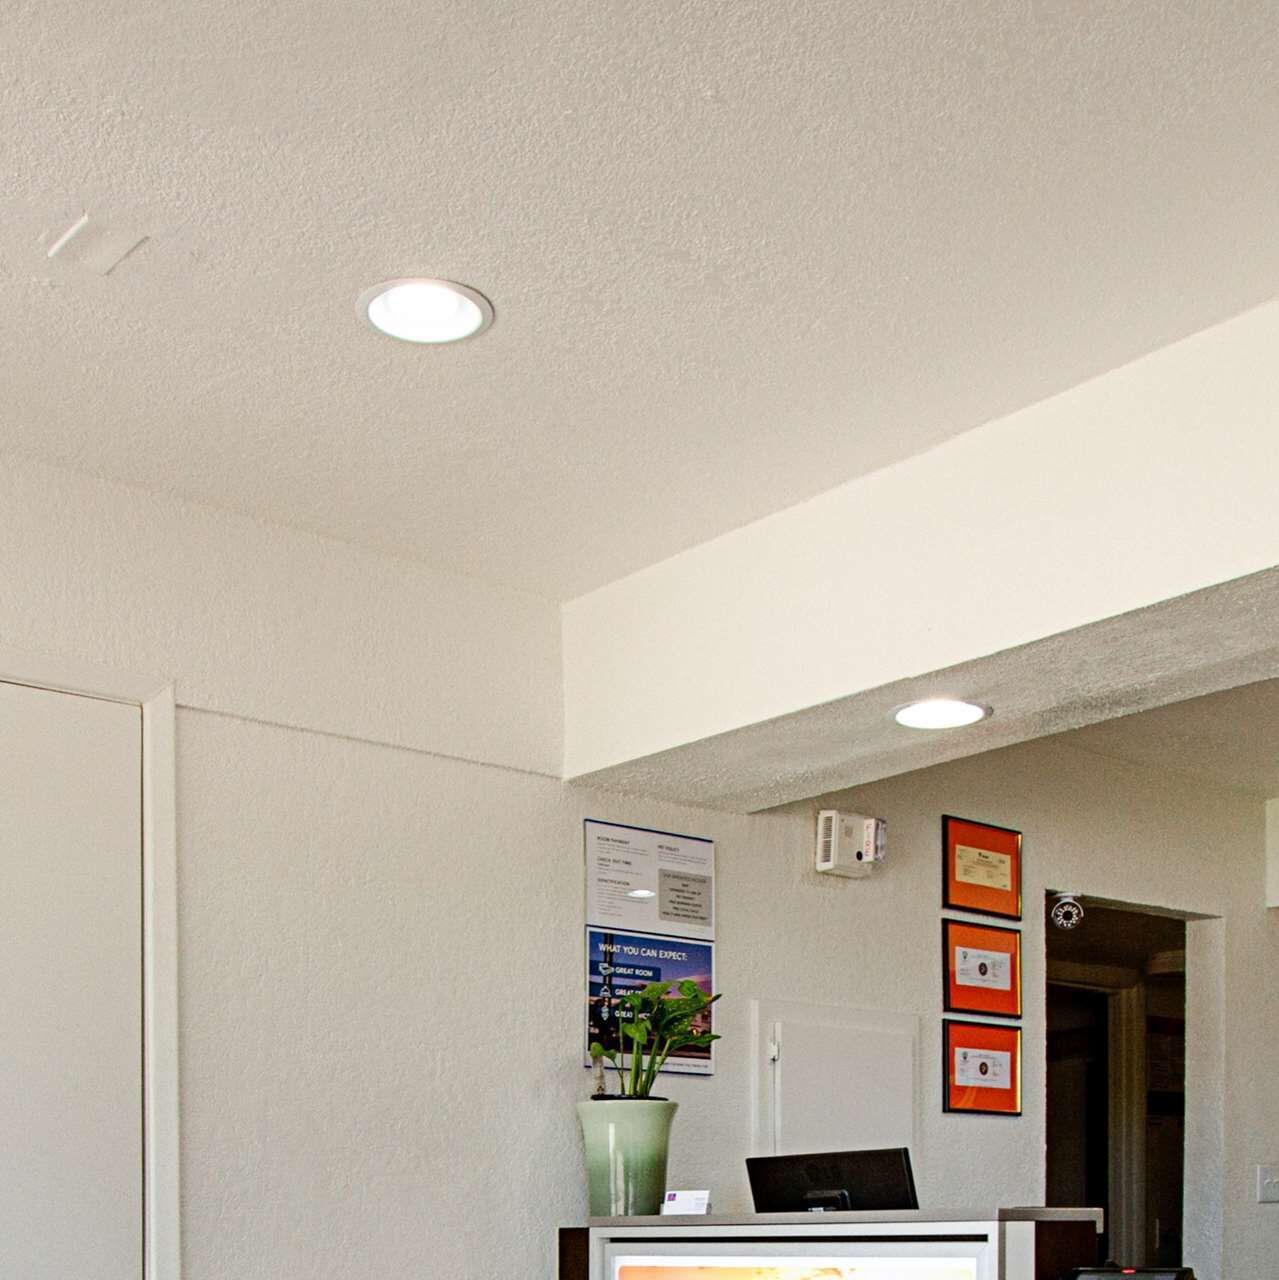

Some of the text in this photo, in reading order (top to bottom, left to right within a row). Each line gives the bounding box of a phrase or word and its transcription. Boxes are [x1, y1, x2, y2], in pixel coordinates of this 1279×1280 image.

[598, 944, 621, 953] WHAT
[623, 946, 639, 955] YOU
[640, 948, 657, 958] CAN
[615, 967, 634, 975] GREAT
